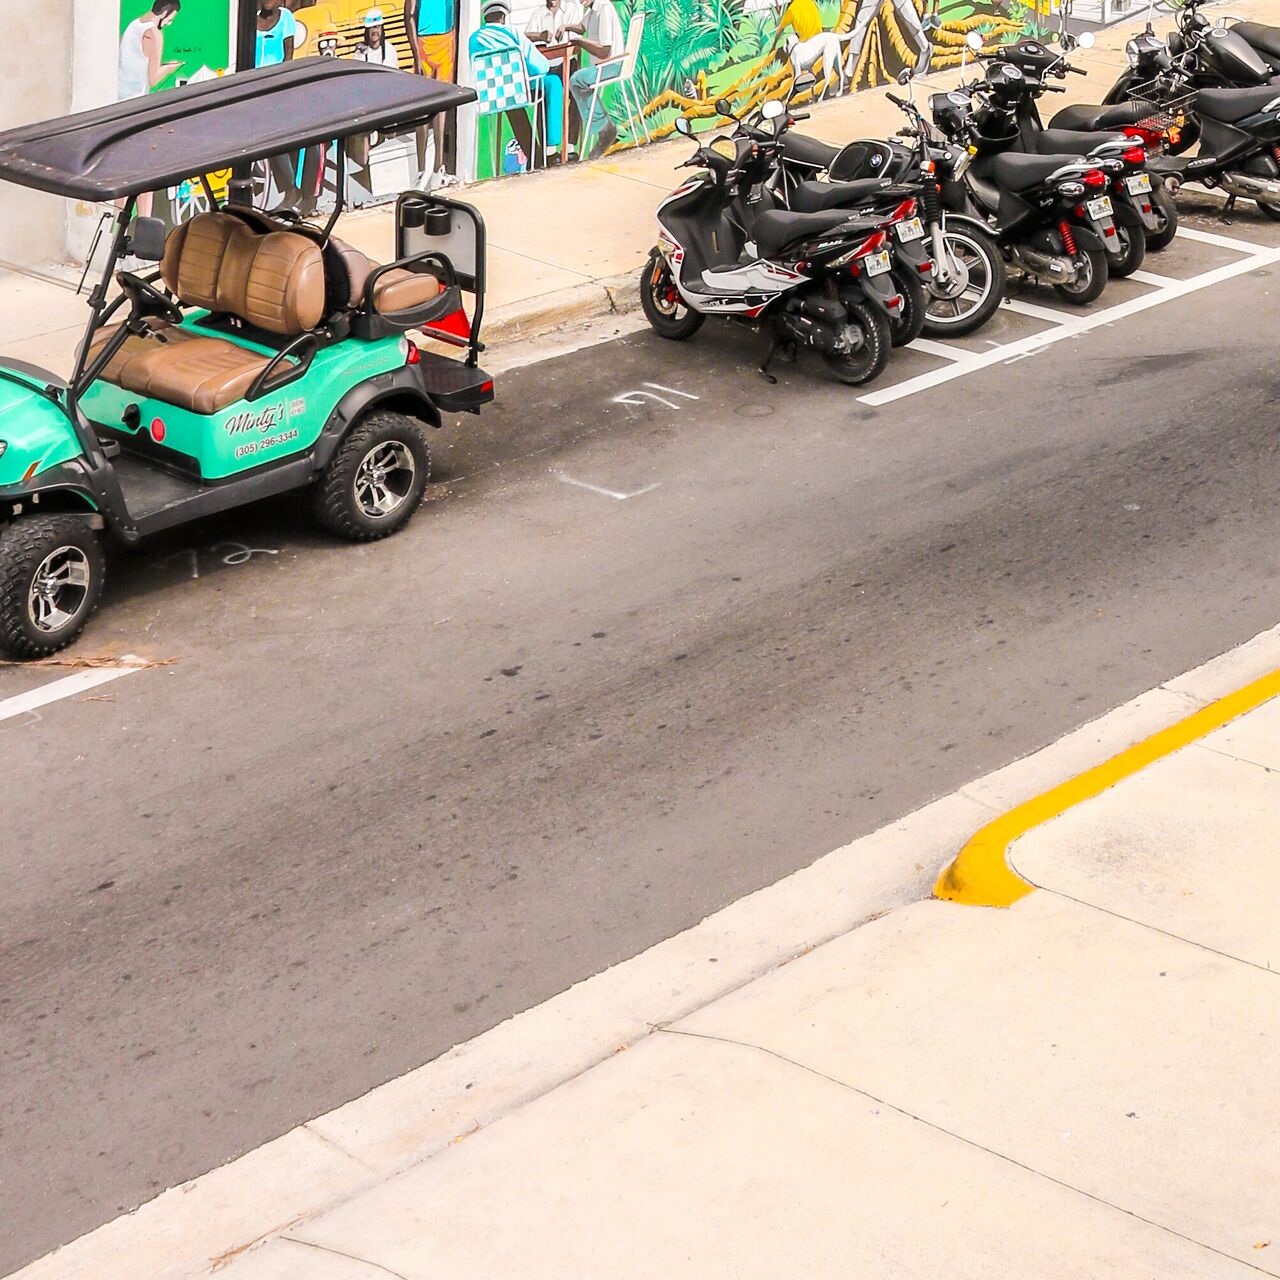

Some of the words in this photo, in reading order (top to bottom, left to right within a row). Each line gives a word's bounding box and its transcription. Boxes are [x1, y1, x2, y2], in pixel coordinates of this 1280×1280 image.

[224, 403, 284, 436] Minty's
[235, 442, 258, 458] (305)
[260, 429, 298, 449] 296-3344
